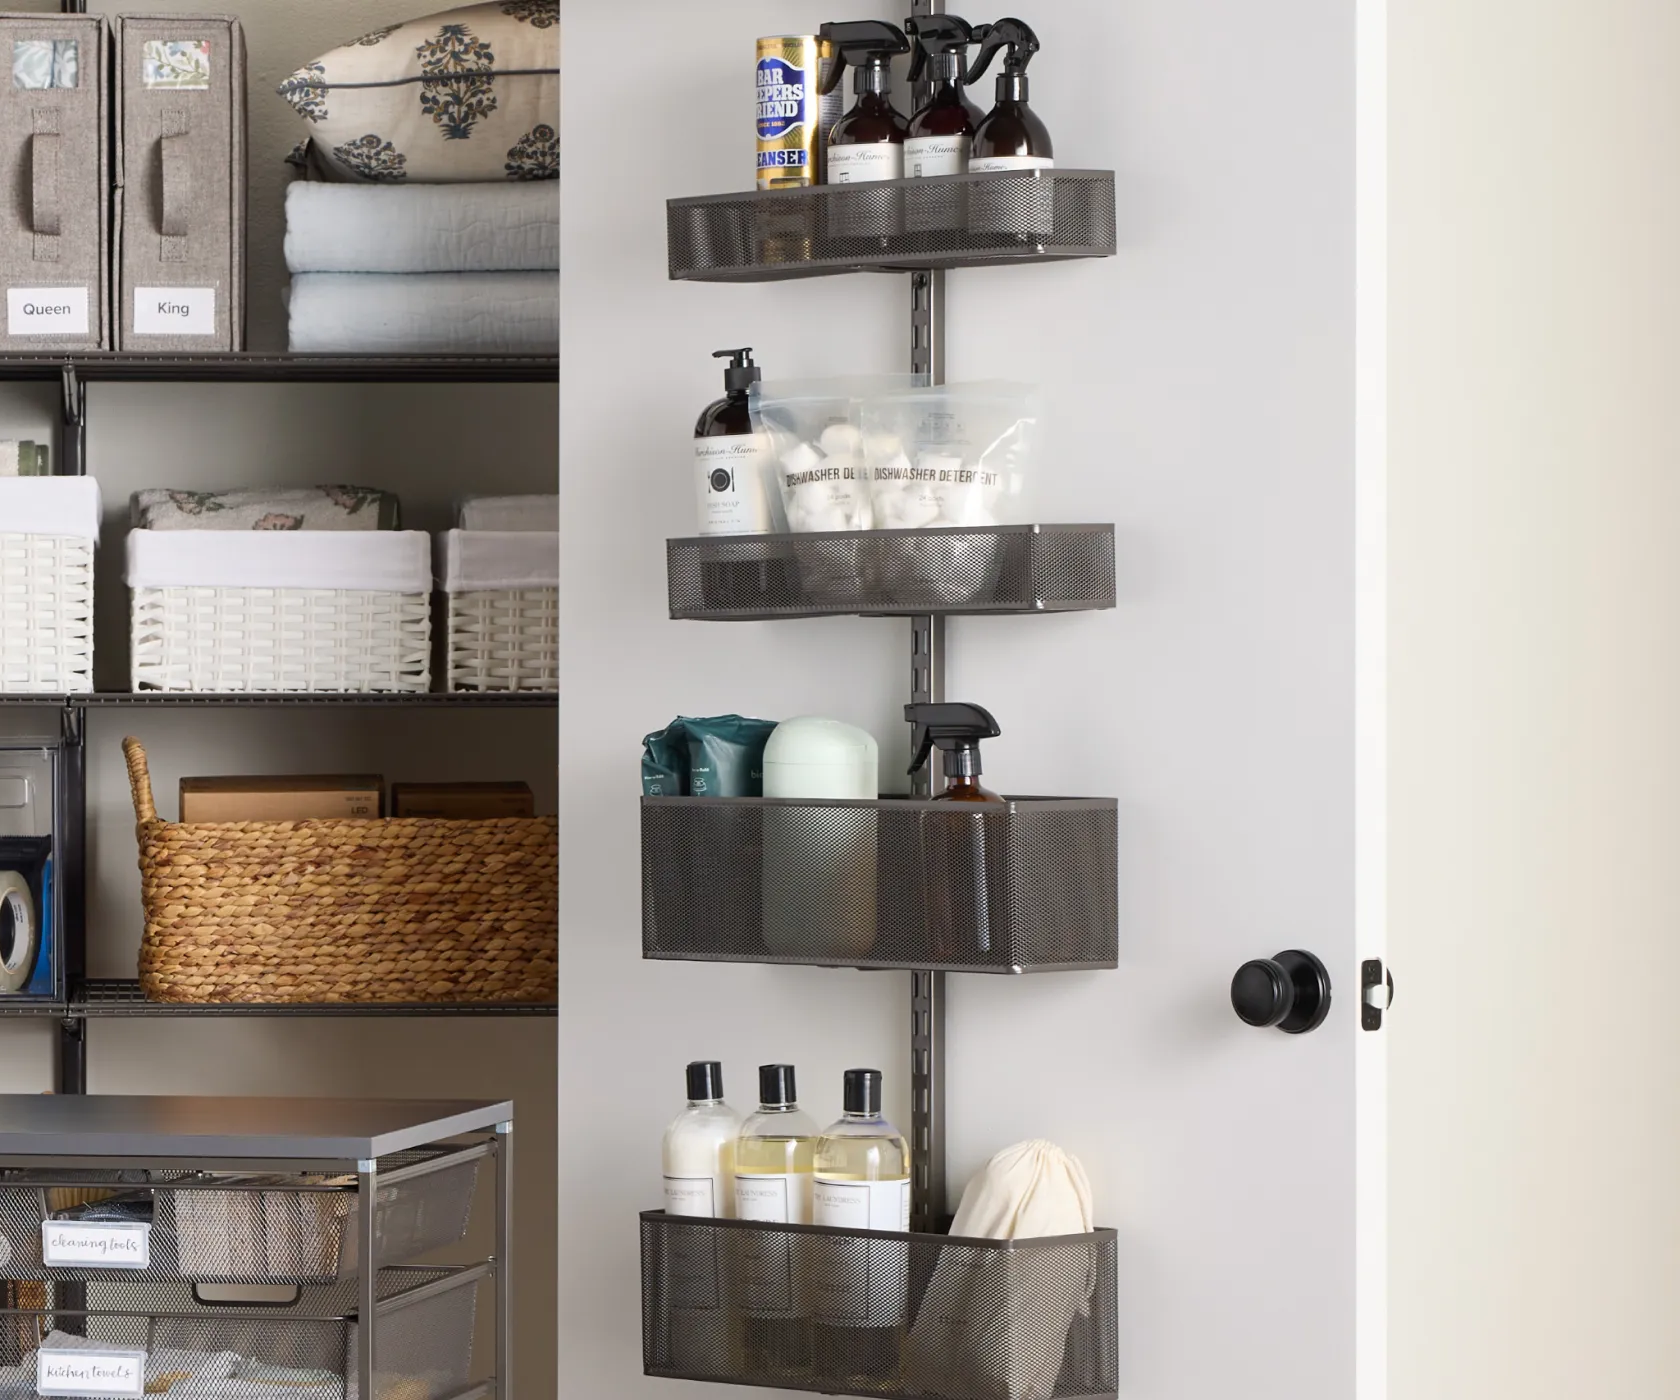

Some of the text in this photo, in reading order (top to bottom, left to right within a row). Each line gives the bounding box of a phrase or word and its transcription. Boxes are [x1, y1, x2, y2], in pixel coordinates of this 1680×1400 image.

[757, 68, 784, 86] BAR
[756, 100, 798, 119] RIEND
[756, 150, 807, 167] EANSER
[23, 303, 71, 316] Queen
[157, 302, 190, 317] King
[874, 467, 936, 481] DISHWASHER
[51, 1233, 140, 1254] cleaning tools
[47, 1364, 133, 1379] kitchen towels
